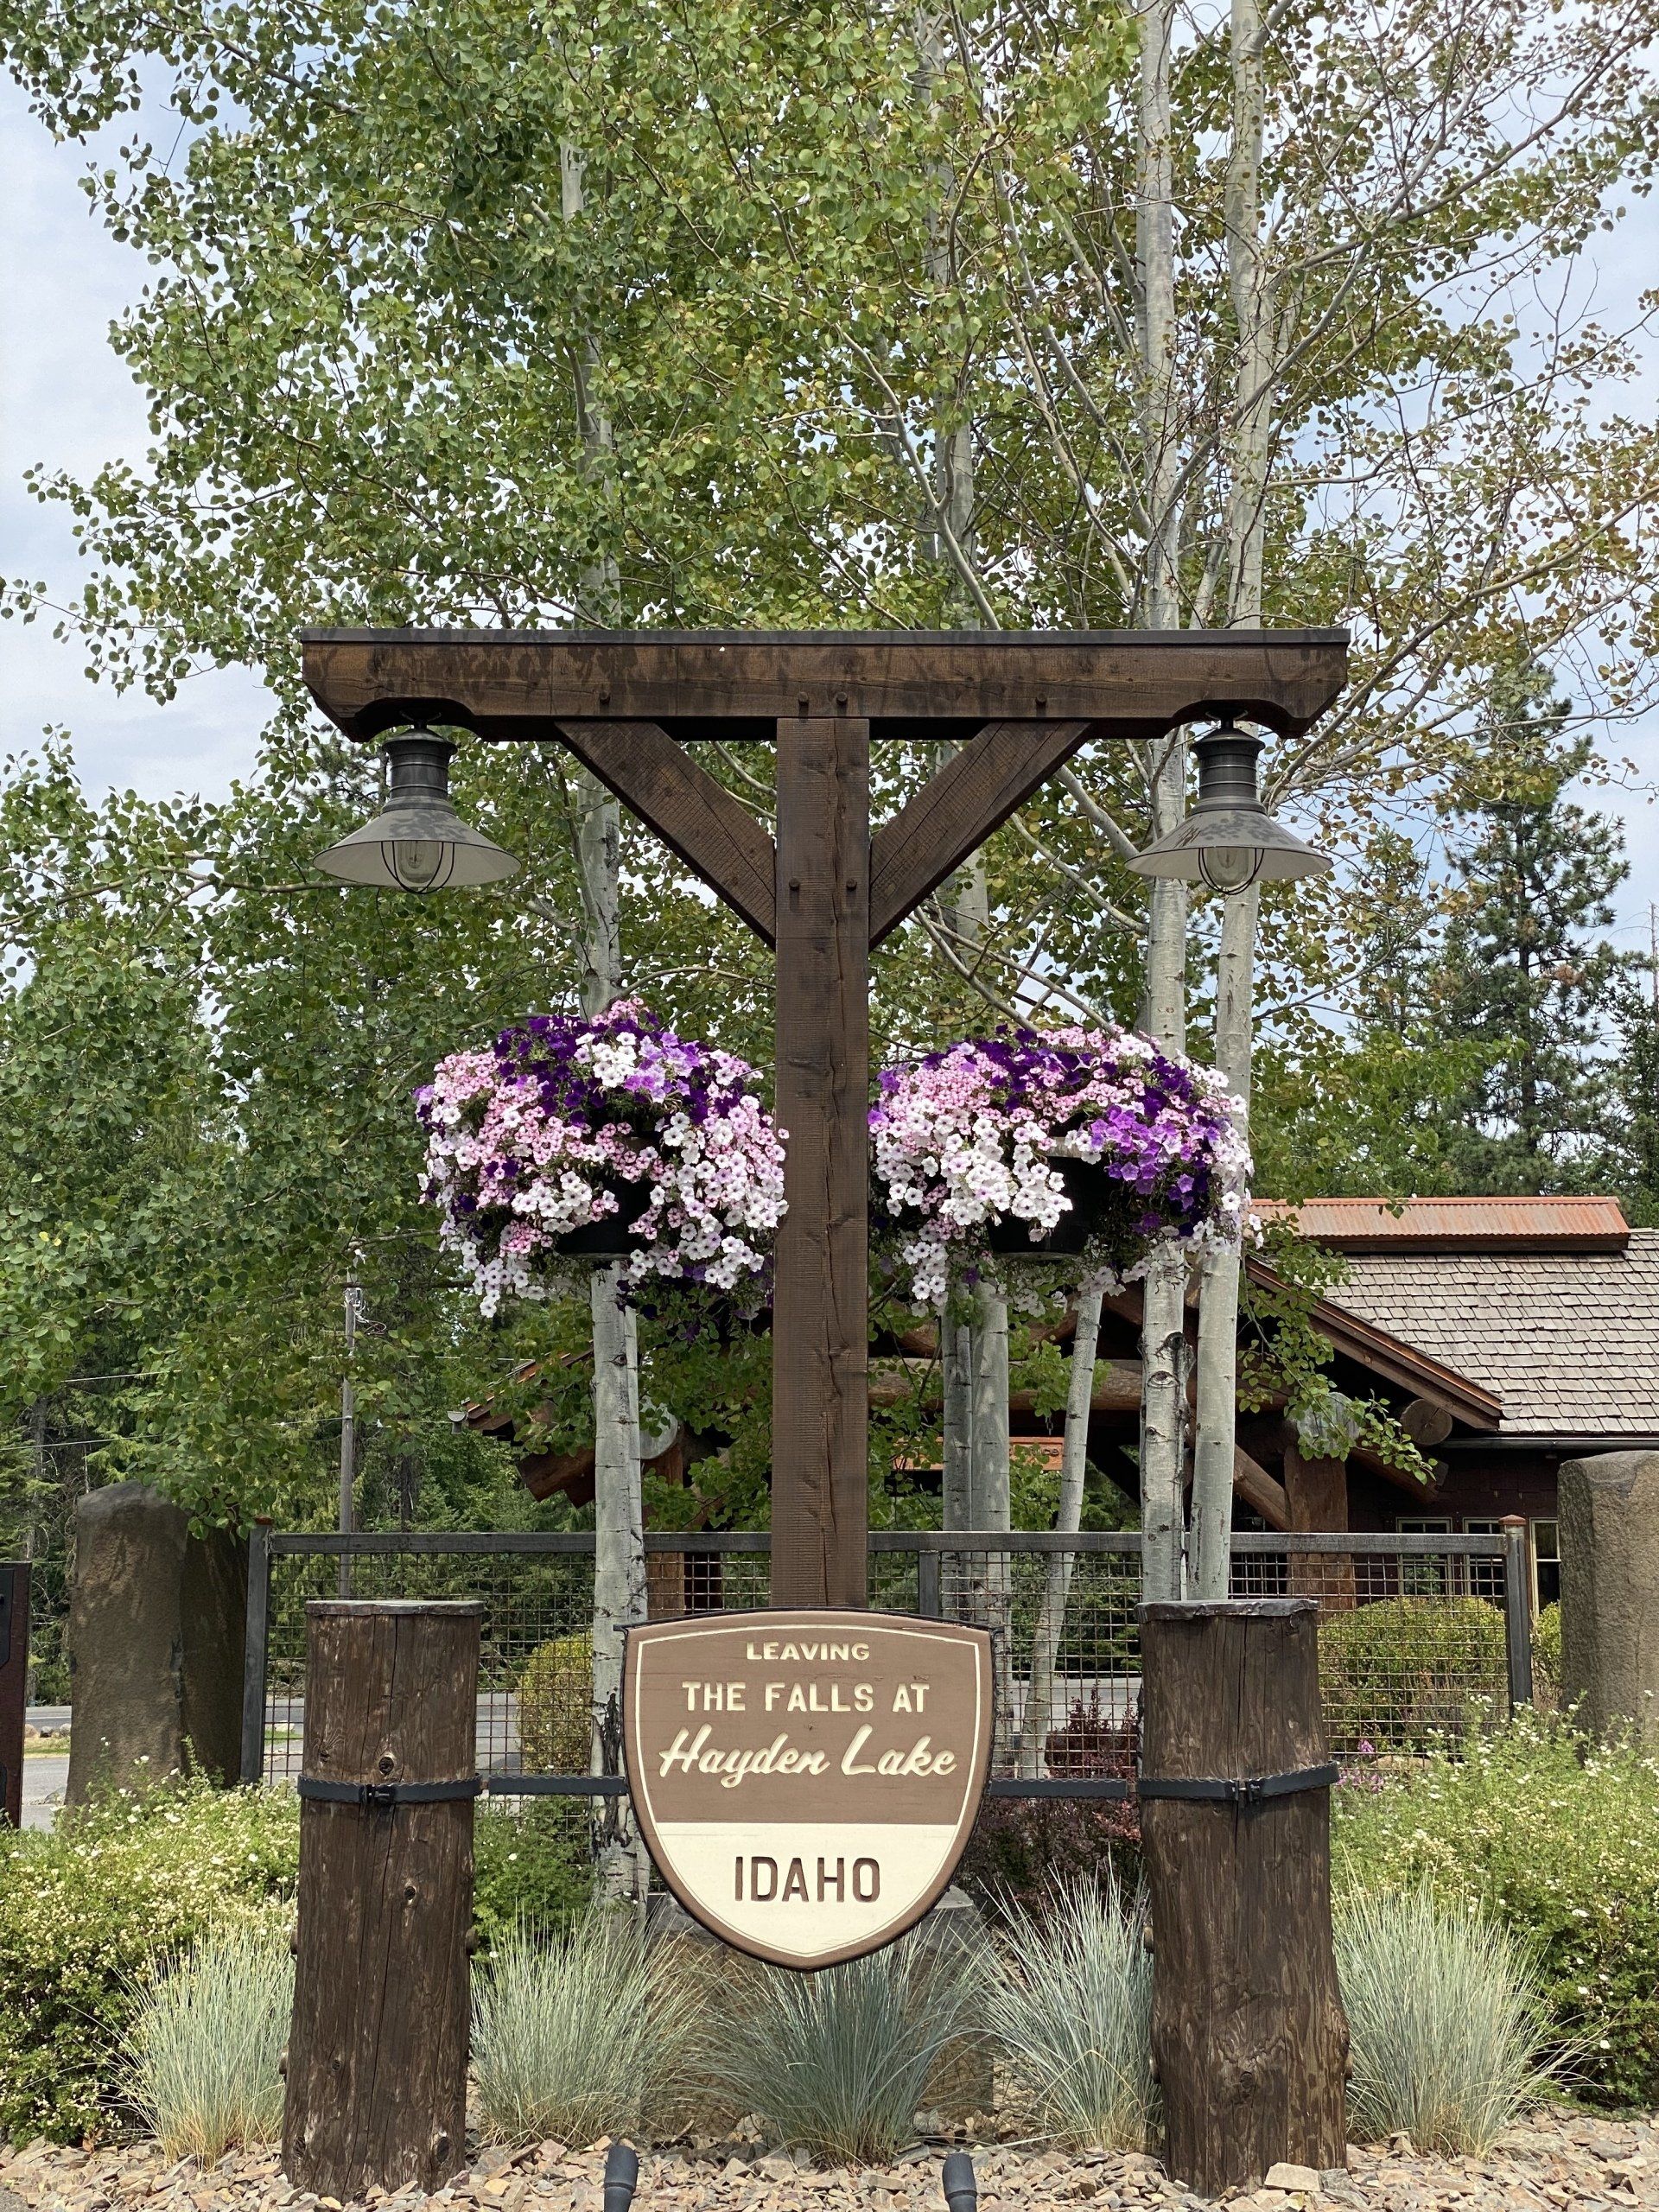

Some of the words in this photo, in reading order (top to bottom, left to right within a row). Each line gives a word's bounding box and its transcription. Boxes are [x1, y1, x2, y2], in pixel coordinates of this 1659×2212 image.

[746, 1641, 870, 1662] LEAVING
[681, 1681, 747, 1713] THE
[764, 1681, 874, 1713] FALLS
[892, 1682, 931, 1713] AT
[658, 1723, 831, 1789] Hayden
[840, 1723, 957, 1777] Lake
[734, 1855, 880, 1904] IDAHO
